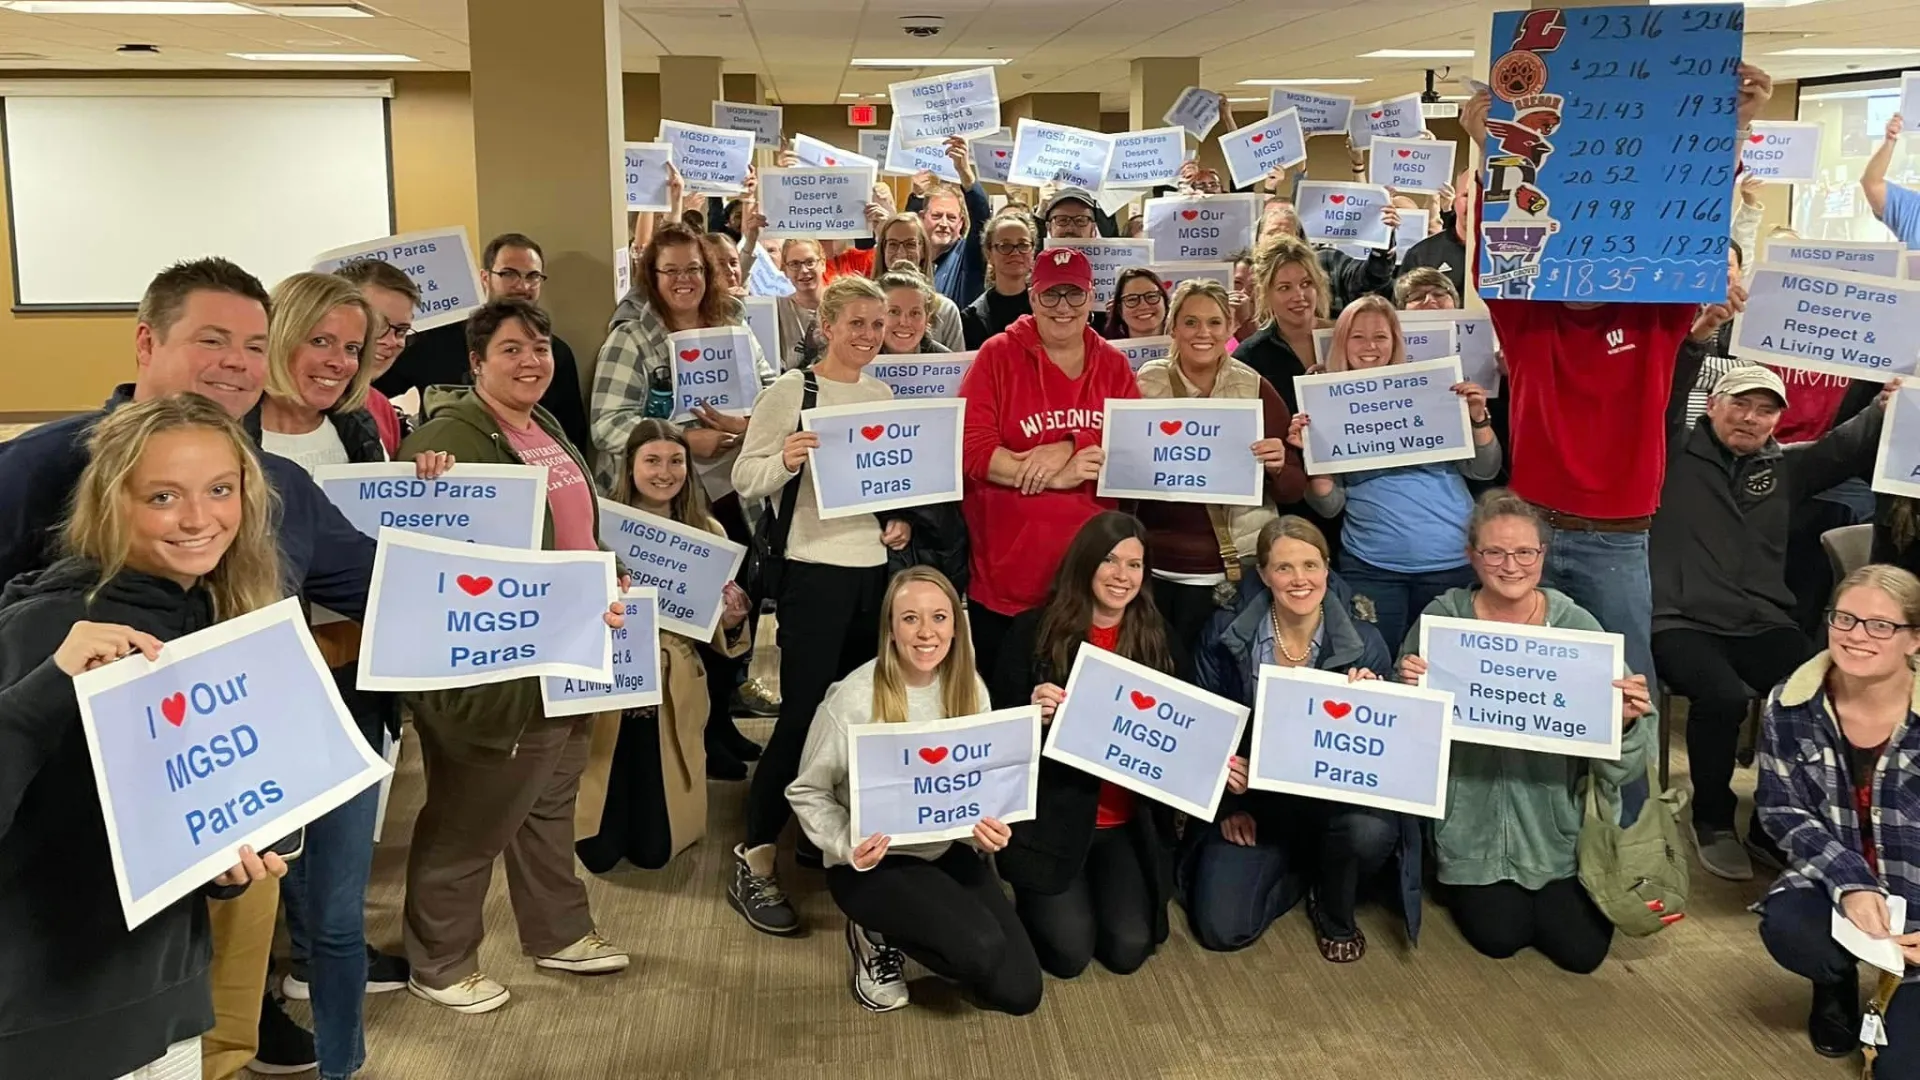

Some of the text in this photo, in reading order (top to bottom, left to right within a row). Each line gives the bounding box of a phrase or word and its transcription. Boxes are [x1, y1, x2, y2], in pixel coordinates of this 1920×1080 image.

[912, 79, 974, 98] MGSD Paras
[925, 95, 966, 109] Deserve
[923, 109, 963, 123] Respect
[925, 120, 985, 136] Living Wage
[1265, 126, 1283, 140] Our
[680, 131, 737, 146] MGSD Paras
[1037, 130, 1094, 148] MGSD Paras
[1115, 136, 1167, 147] MGSD Paras
[1766, 135, 1792, 145] Our
[688, 145, 726, 157] Deserve
[1045, 144, 1080, 158] Deserve
[1125, 147, 1159, 158] Deserve
[1253, 140, 1284, 158] MGSD
[1412, 151, 1431, 160] Our
[1743, 149, 1784, 160] MGSD
[682, 155, 719, 169] Respect
[914, 158, 942, 171] Paras
[1037, 156, 1072, 169] Respect
[1121, 159, 1156, 170] Respect
[1393, 163, 1425, 173] MGSD
[1743, 164, 1779, 175] Paras
[710, 172, 736, 183] Wage
[782, 175, 849, 186] MGSD Paras
[1062, 172, 1088, 186] Wage
[1122, 168, 1174, 180] Living Wage
[1393, 176, 1422, 186] Paras
[794, 191, 838, 201] Deserve
[1346, 195, 1369, 207] Our
[789, 206, 833, 216] Respect
[1201, 210, 1225, 221] Our
[1325, 210, 1361, 221] MGSD
[789, 219, 855, 230] Living Wage
[1324, 226, 1358, 236] Paras
[1179, 227, 1220, 239] MGSD
[393, 242, 437, 260] Paras
[1053, 251, 1072, 266] W
[1104, 247, 1133, 257] Paras
[1180, 245, 1218, 257] Paras
[1790, 248, 1875, 262] MGSD Paras
[1781, 275, 1897, 305] MGSD Paras
[419, 295, 460, 314] Wage
[1797, 300, 1872, 322] Deserve
[1606, 329, 1624, 347] W
[1783, 318, 1876, 344] Respect &
[703, 347, 733, 361] Our
[1761, 335, 1892, 368] A Living Wage
[678, 369, 729, 386] MGSD
[875, 364, 961, 378] MGSD Paras
[890, 384, 945, 395] Deserve
[1328, 376, 1428, 398] MGSD Paras
[1349, 398, 1413, 415] Deserve
[887, 423, 921, 439] Our
[1185, 421, 1221, 437] Our
[1344, 415, 1424, 436] Respect &
[1331, 433, 1444, 457] A Living Wage
[856, 448, 913, 469] MGSD
[1153, 446, 1211, 462] MGSD
[861, 478, 911, 496] Paras
[1154, 472, 1207, 487] Paras
[359, 480, 497, 500] MGSD Paras
[380, 511, 470, 527] Deserve
[620, 519, 711, 558] MGSD Paras
[629, 544, 688, 573] Deserve
[438, 572, 551, 599] I Our
[676, 582, 687, 595] &
[658, 596, 695, 619] Wage
[447, 610, 540, 632] MGSD
[1460, 633, 1580, 659] MGSD Paras
[450, 643, 536, 667] Paras
[1480, 660, 1557, 681] Deserve
[615, 675, 644, 690] Wage
[1470, 683, 1566, 707] Respect &
[146, 672, 249, 739] I Our
[1115, 685, 1196, 730] I Our
[1308, 698, 1397, 728] I Our
[1452, 705, 1587, 738] A Living Wage
[1112, 715, 1177, 754] MGSD
[1314, 729, 1385, 757] MGSD
[165, 724, 259, 793] MGSD
[952, 743, 992, 762] Our
[1105, 744, 1164, 780] Paras
[1314, 760, 1379, 787] Paras
[914, 770, 982, 794] MGSD
[185, 779, 284, 846] Paras
[918, 802, 981, 824] Paras
